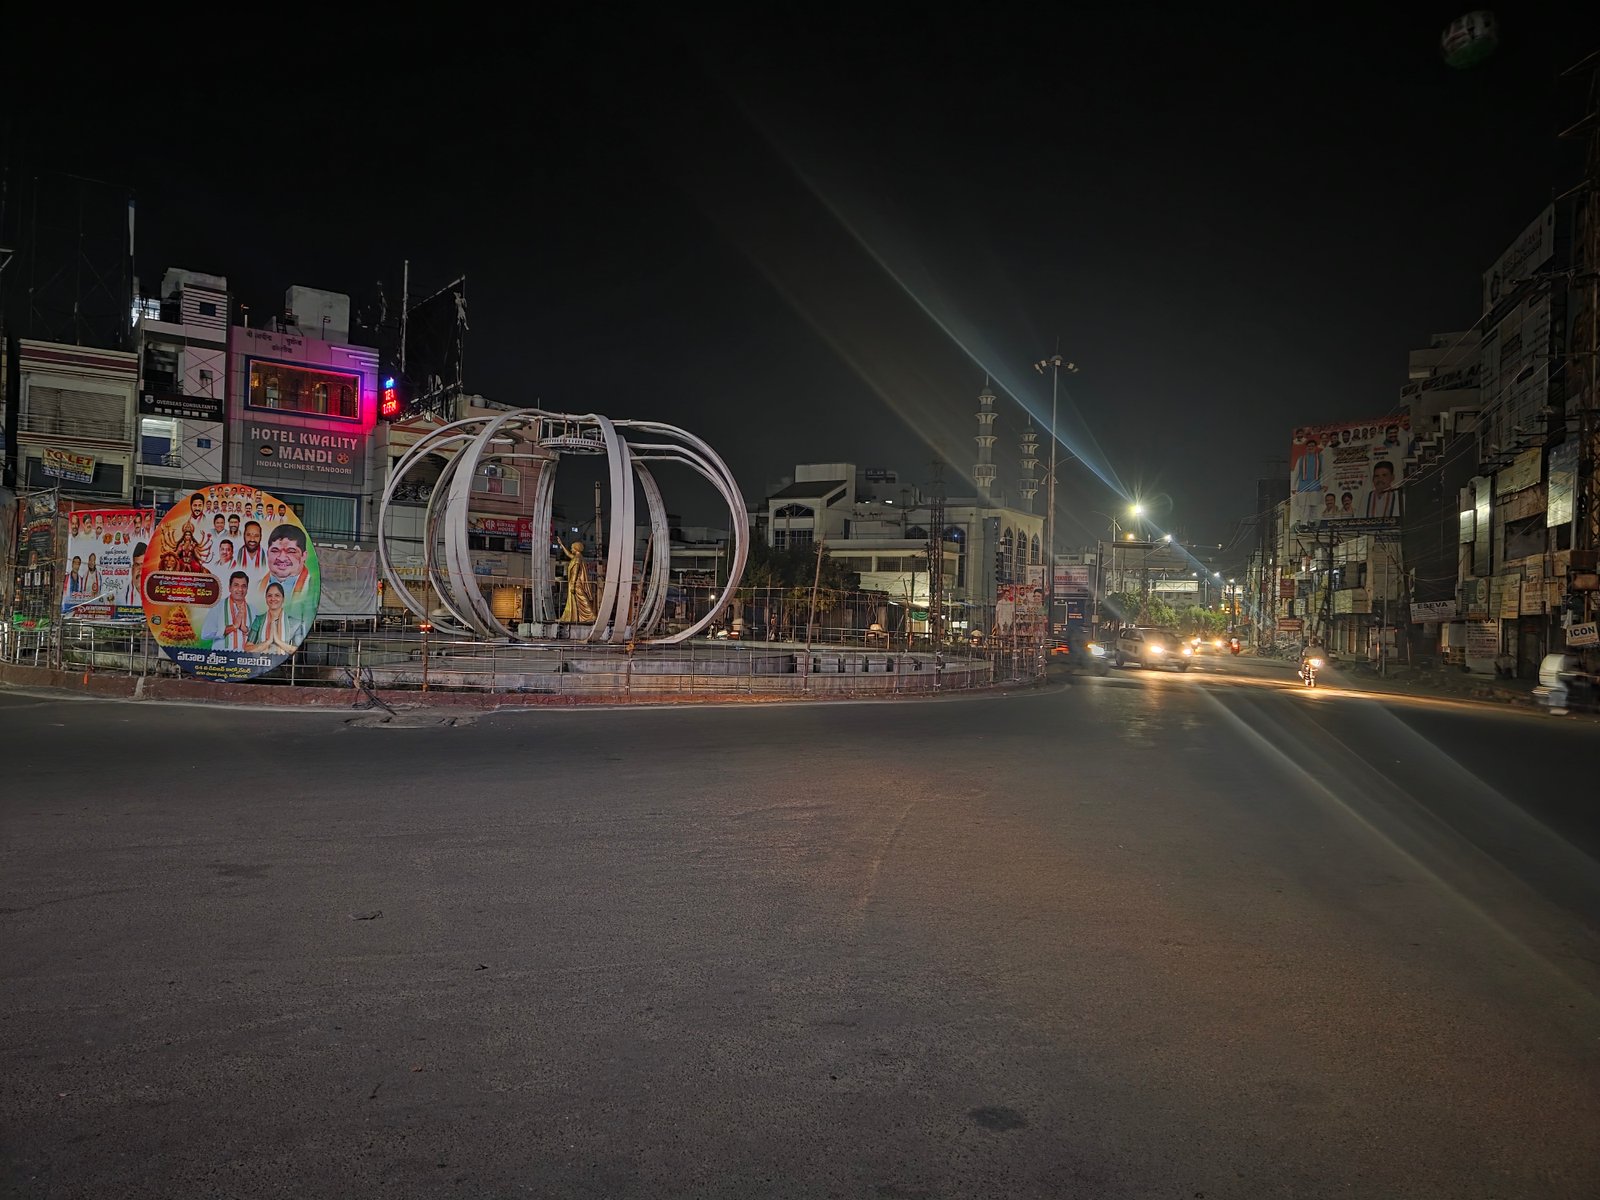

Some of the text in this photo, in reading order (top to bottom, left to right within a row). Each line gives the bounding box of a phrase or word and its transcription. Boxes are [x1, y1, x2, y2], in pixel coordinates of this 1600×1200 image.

[183, 402, 218, 411] CONSULTANTS
[251, 428, 358, 450] HOTEL KWALITY
[68, 455, 93, 465] LET
[278, 446, 332, 463] MANDI
[256, 460, 352, 474] INDIAN CHINESE TANDOORI
[485, 520, 496, 530] AR
[1418, 601, 1448, 609] ESEVA
[1569, 626, 1595, 637] ICON
[177, 651, 205, 662] పడాల
[236, 655, 272, 666] అజయ్
